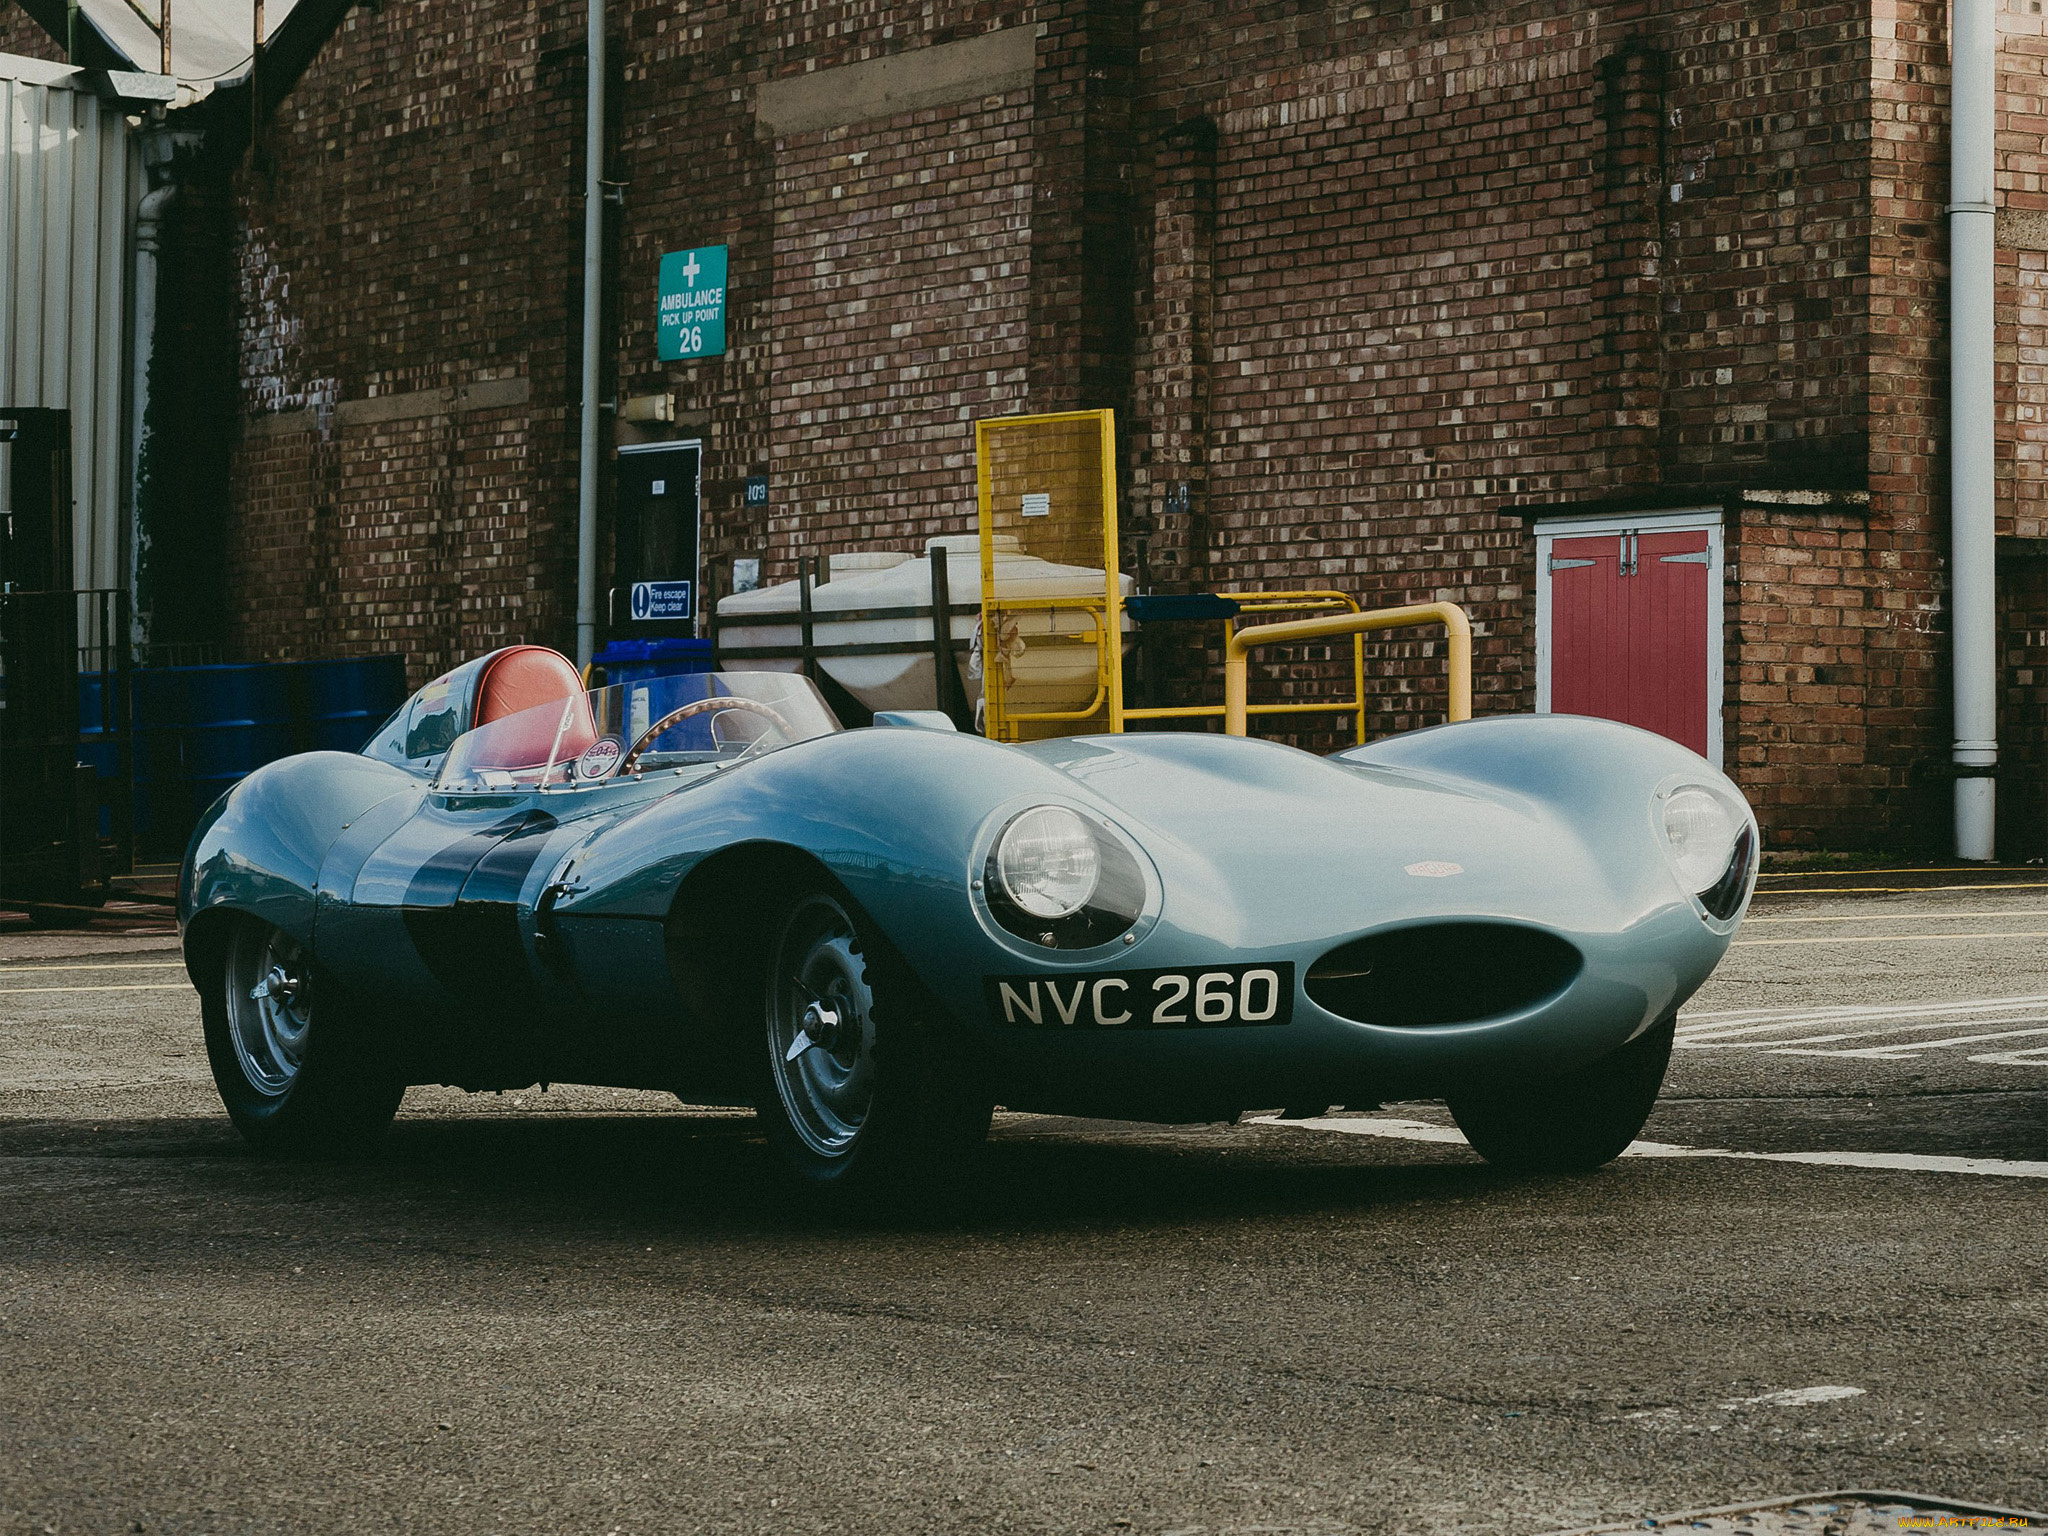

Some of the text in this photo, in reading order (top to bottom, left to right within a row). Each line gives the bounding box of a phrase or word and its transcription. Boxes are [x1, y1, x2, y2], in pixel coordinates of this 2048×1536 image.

[660, 288, 723, 311] AMBULANCE
[662, 307, 719, 326] PICK UP POINT
[679, 326, 702, 353] 26
[651, 589, 687, 601] Fire escape
[650, 601, 683, 614] Keep clear
[998, 969, 1278, 1025] NVC 260
